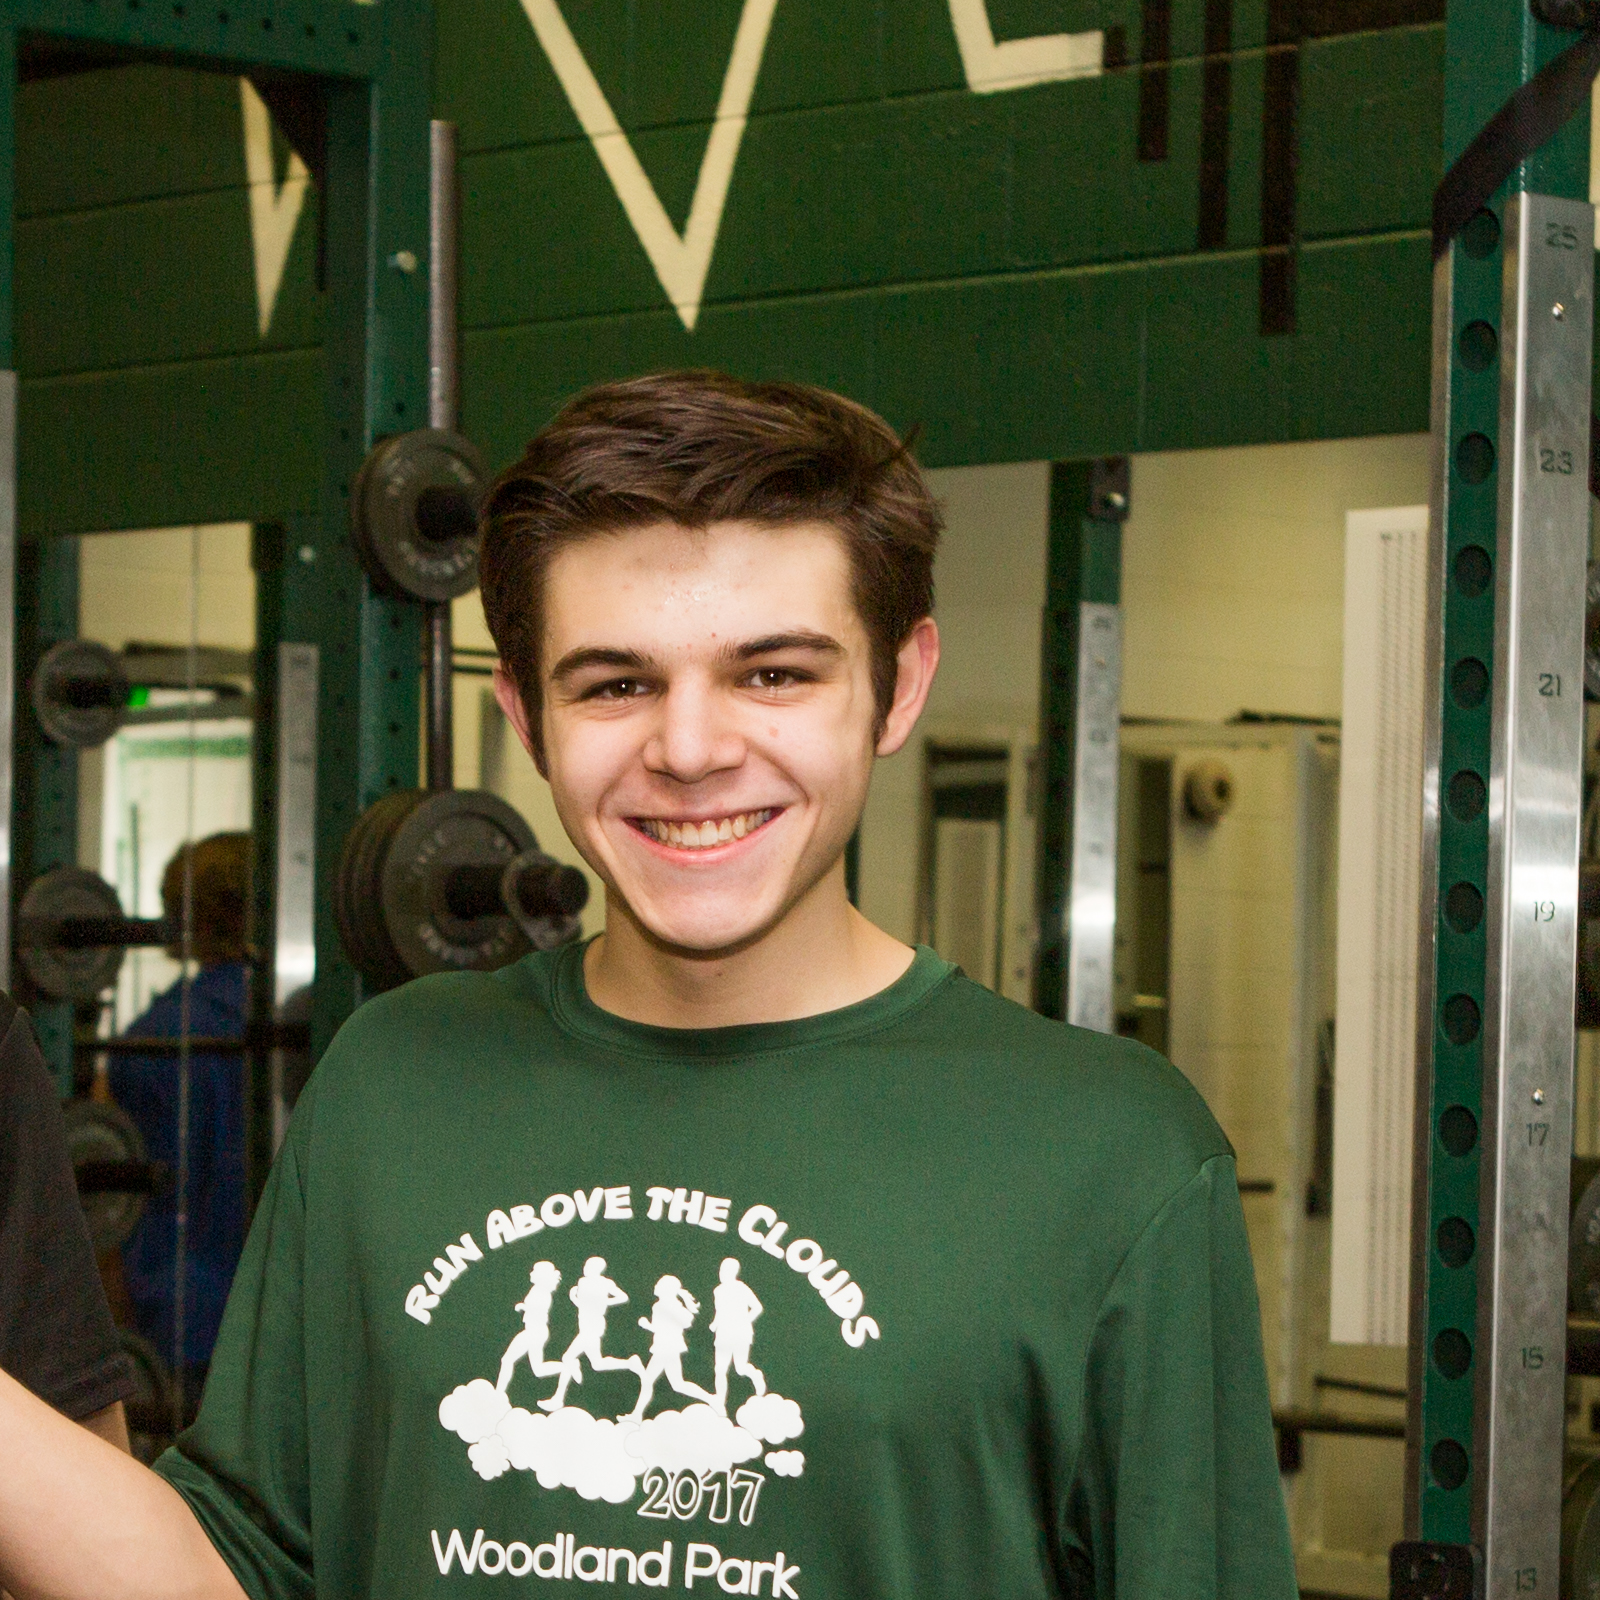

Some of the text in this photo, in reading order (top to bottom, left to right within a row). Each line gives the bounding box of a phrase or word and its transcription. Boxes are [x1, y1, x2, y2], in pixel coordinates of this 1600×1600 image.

[1544, 221, 1578, 250] 25
[1540, 448, 1573, 475] 23
[1538, 673, 1561, 697] 21
[1532, 900, 1556, 923] 19
[1526, 1122, 1550, 1147] 17
[404, 1185, 880, 1349] RUN ABOVE THE CLOUDS
[1520, 1346, 1544, 1370] 15
[636, 1466, 765, 1526] 2017
[430, 1528, 801, 1600] Woodland Park
[1514, 1566, 1538, 1593] 13
